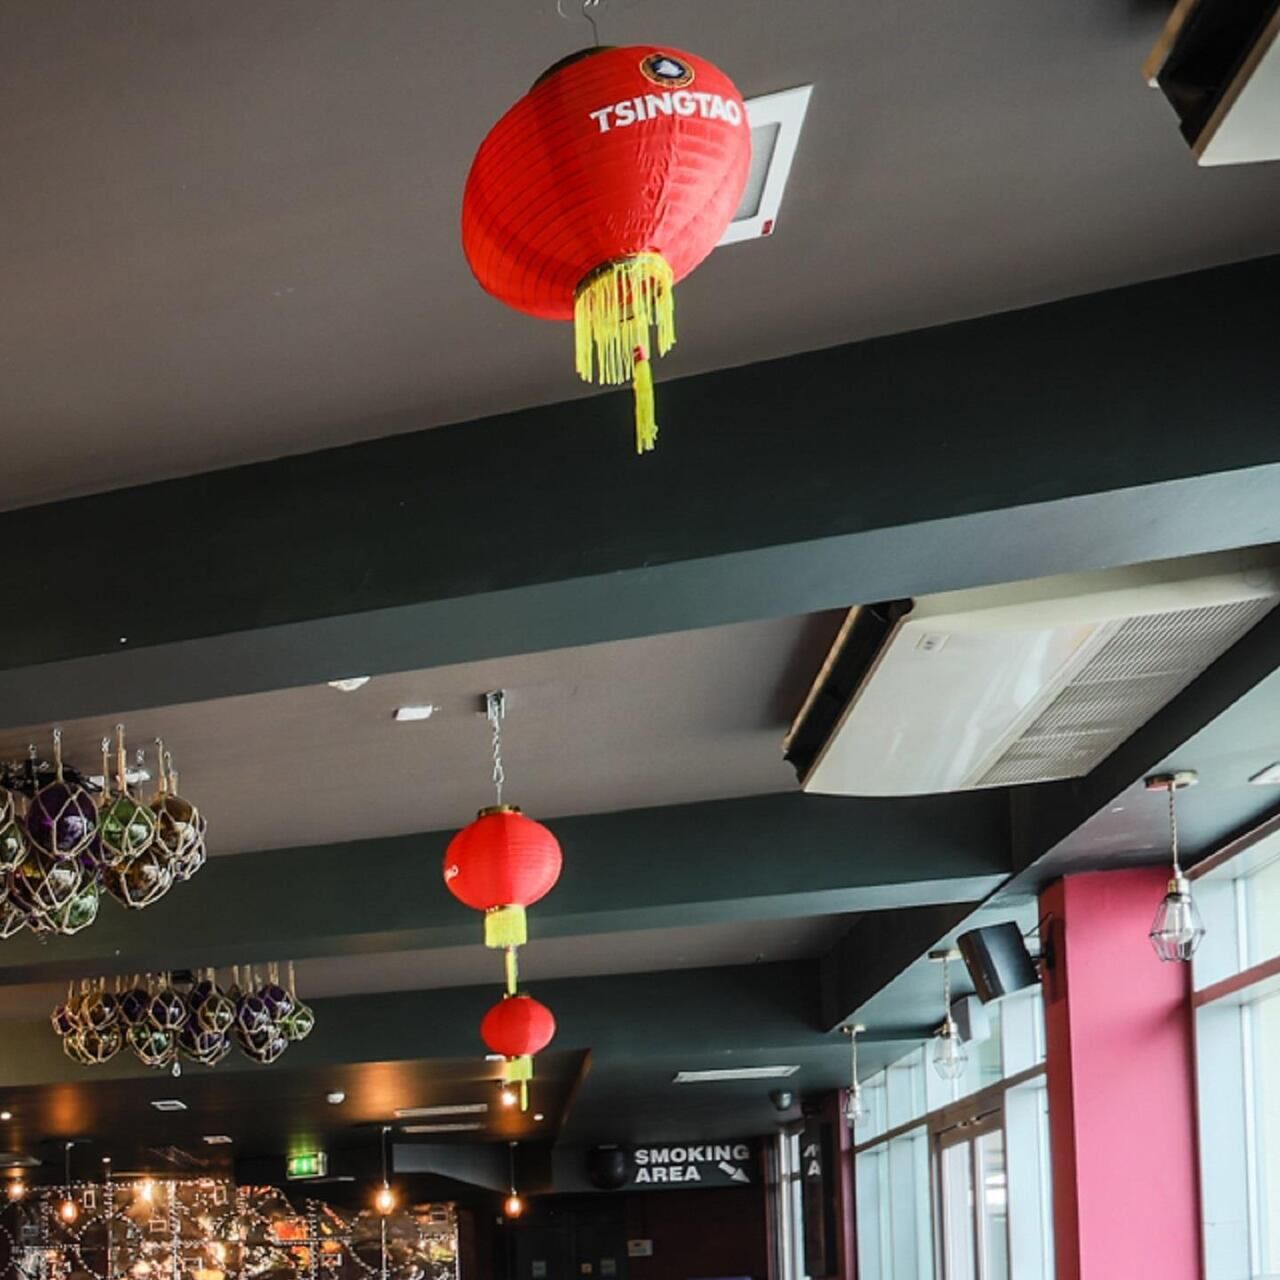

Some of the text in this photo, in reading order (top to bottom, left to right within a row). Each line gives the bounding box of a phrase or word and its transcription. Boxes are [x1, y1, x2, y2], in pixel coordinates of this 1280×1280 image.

[589, 89, 742, 133] TSINGTAO
[634, 1144, 750, 1164] SMOKING
[634, 1166, 701, 1183] AREA
